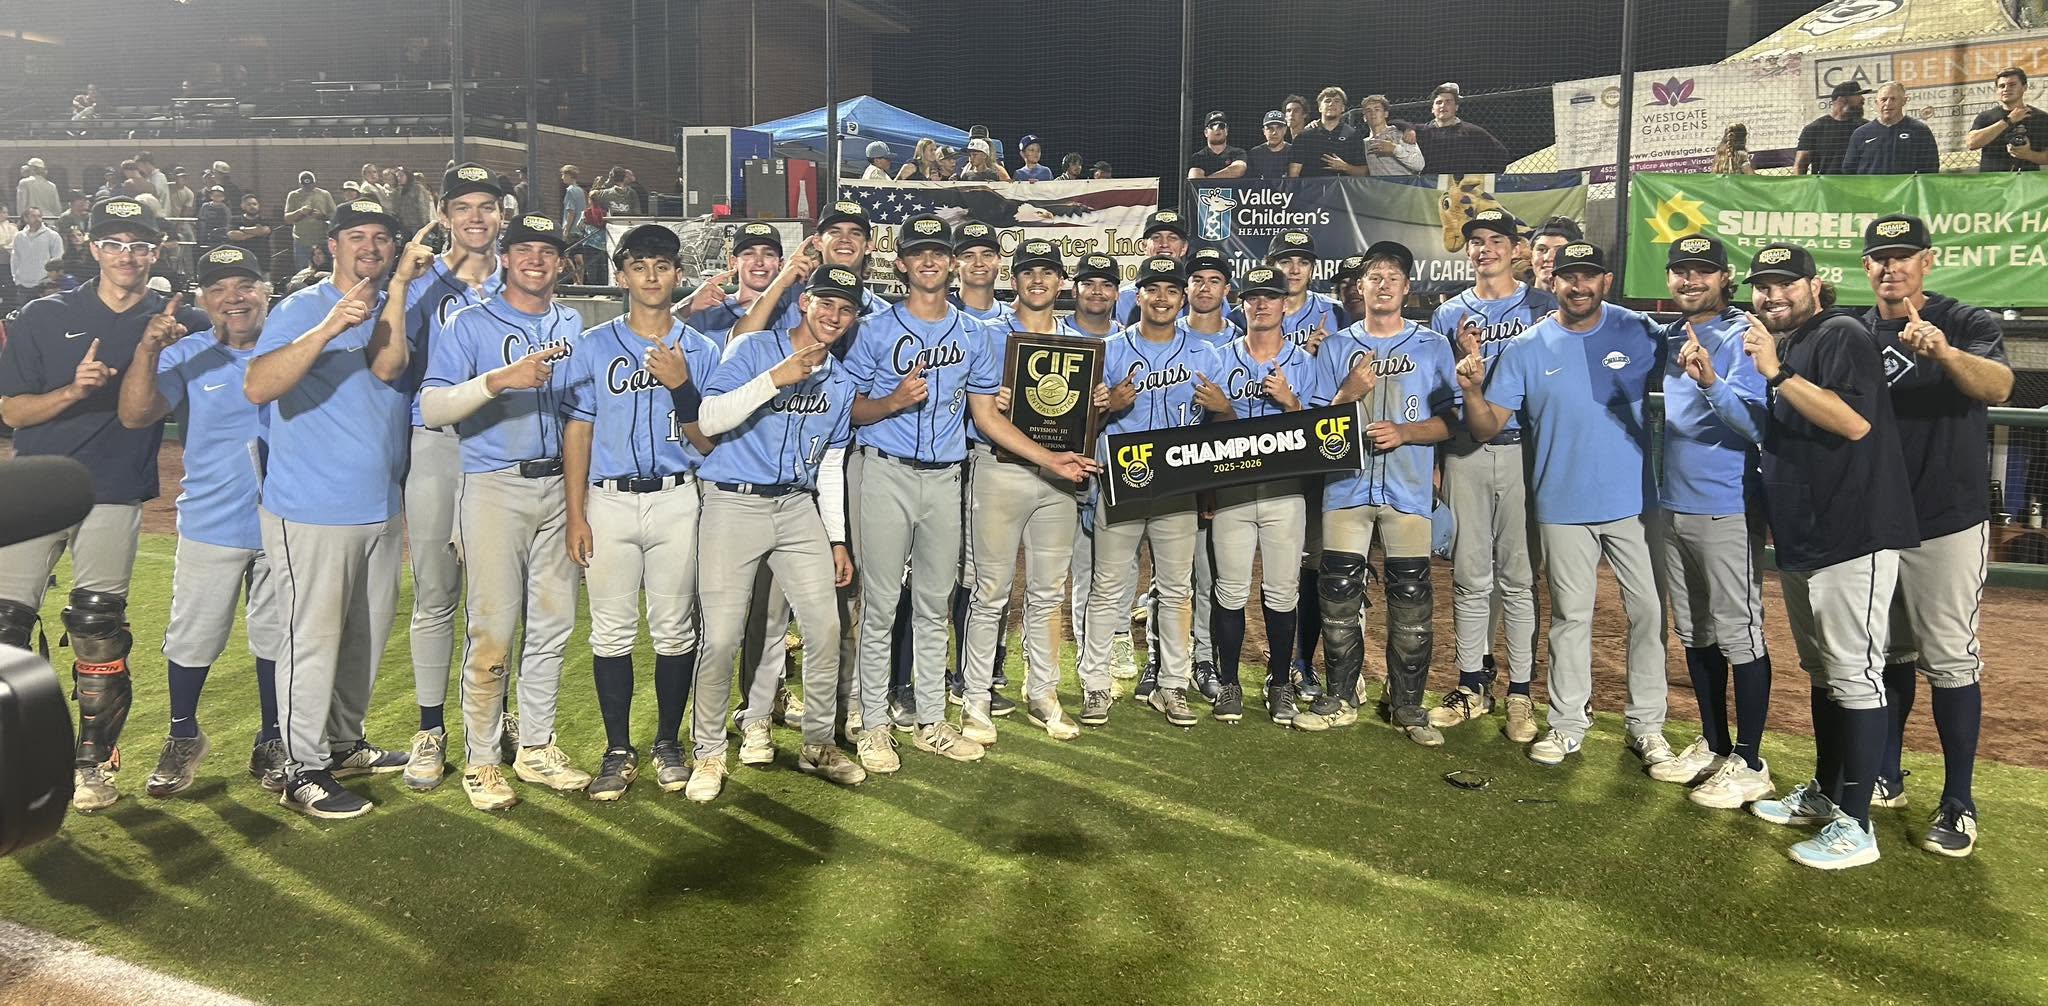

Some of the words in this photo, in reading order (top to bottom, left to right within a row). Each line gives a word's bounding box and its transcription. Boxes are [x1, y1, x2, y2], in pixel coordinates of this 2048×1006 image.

[1823, 62, 1892, 88] CAL
[1952, 85, 1997, 98] PLANN
[1641, 119, 1708, 135] GARDENS
[1642, 108, 1708, 123] WESTGATE
[1630, 146, 1716, 160] www.GoWestgate.co
[1238, 188, 1294, 209] Valley
[1237, 208, 1330, 226] Children's
[1717, 210, 1879, 238] SUNBELT
[1928, 210, 2013, 234] WORK
[998, 228, 1098, 258] Crter
[1238, 227, 1309, 236] HEALTHCE
[1738, 237, 1852, 249] RENTALS
[1932, 245, 2001, 266] RENT
[893, 334, 965, 376] Cavs
[1028, 350, 1084, 382] CIF
[607, 356, 665, 395] Ca
[1128, 361, 1192, 393] Cavs
[1027, 389, 1051, 415] CENTRAL
[1051, 392, 1078, 415] SECTION
[1404, 394, 1420, 422] 8
[1029, 426, 1058, 434] DIVISION
[1315, 416, 1350, 441] CIF
[1037, 442, 1066, 450] AMPIONS
[1117, 442, 1154, 469] CIF
[1165, 428, 1307, 468] CHAMPIONS
[1213, 458, 1262, 473] 2025-2026
